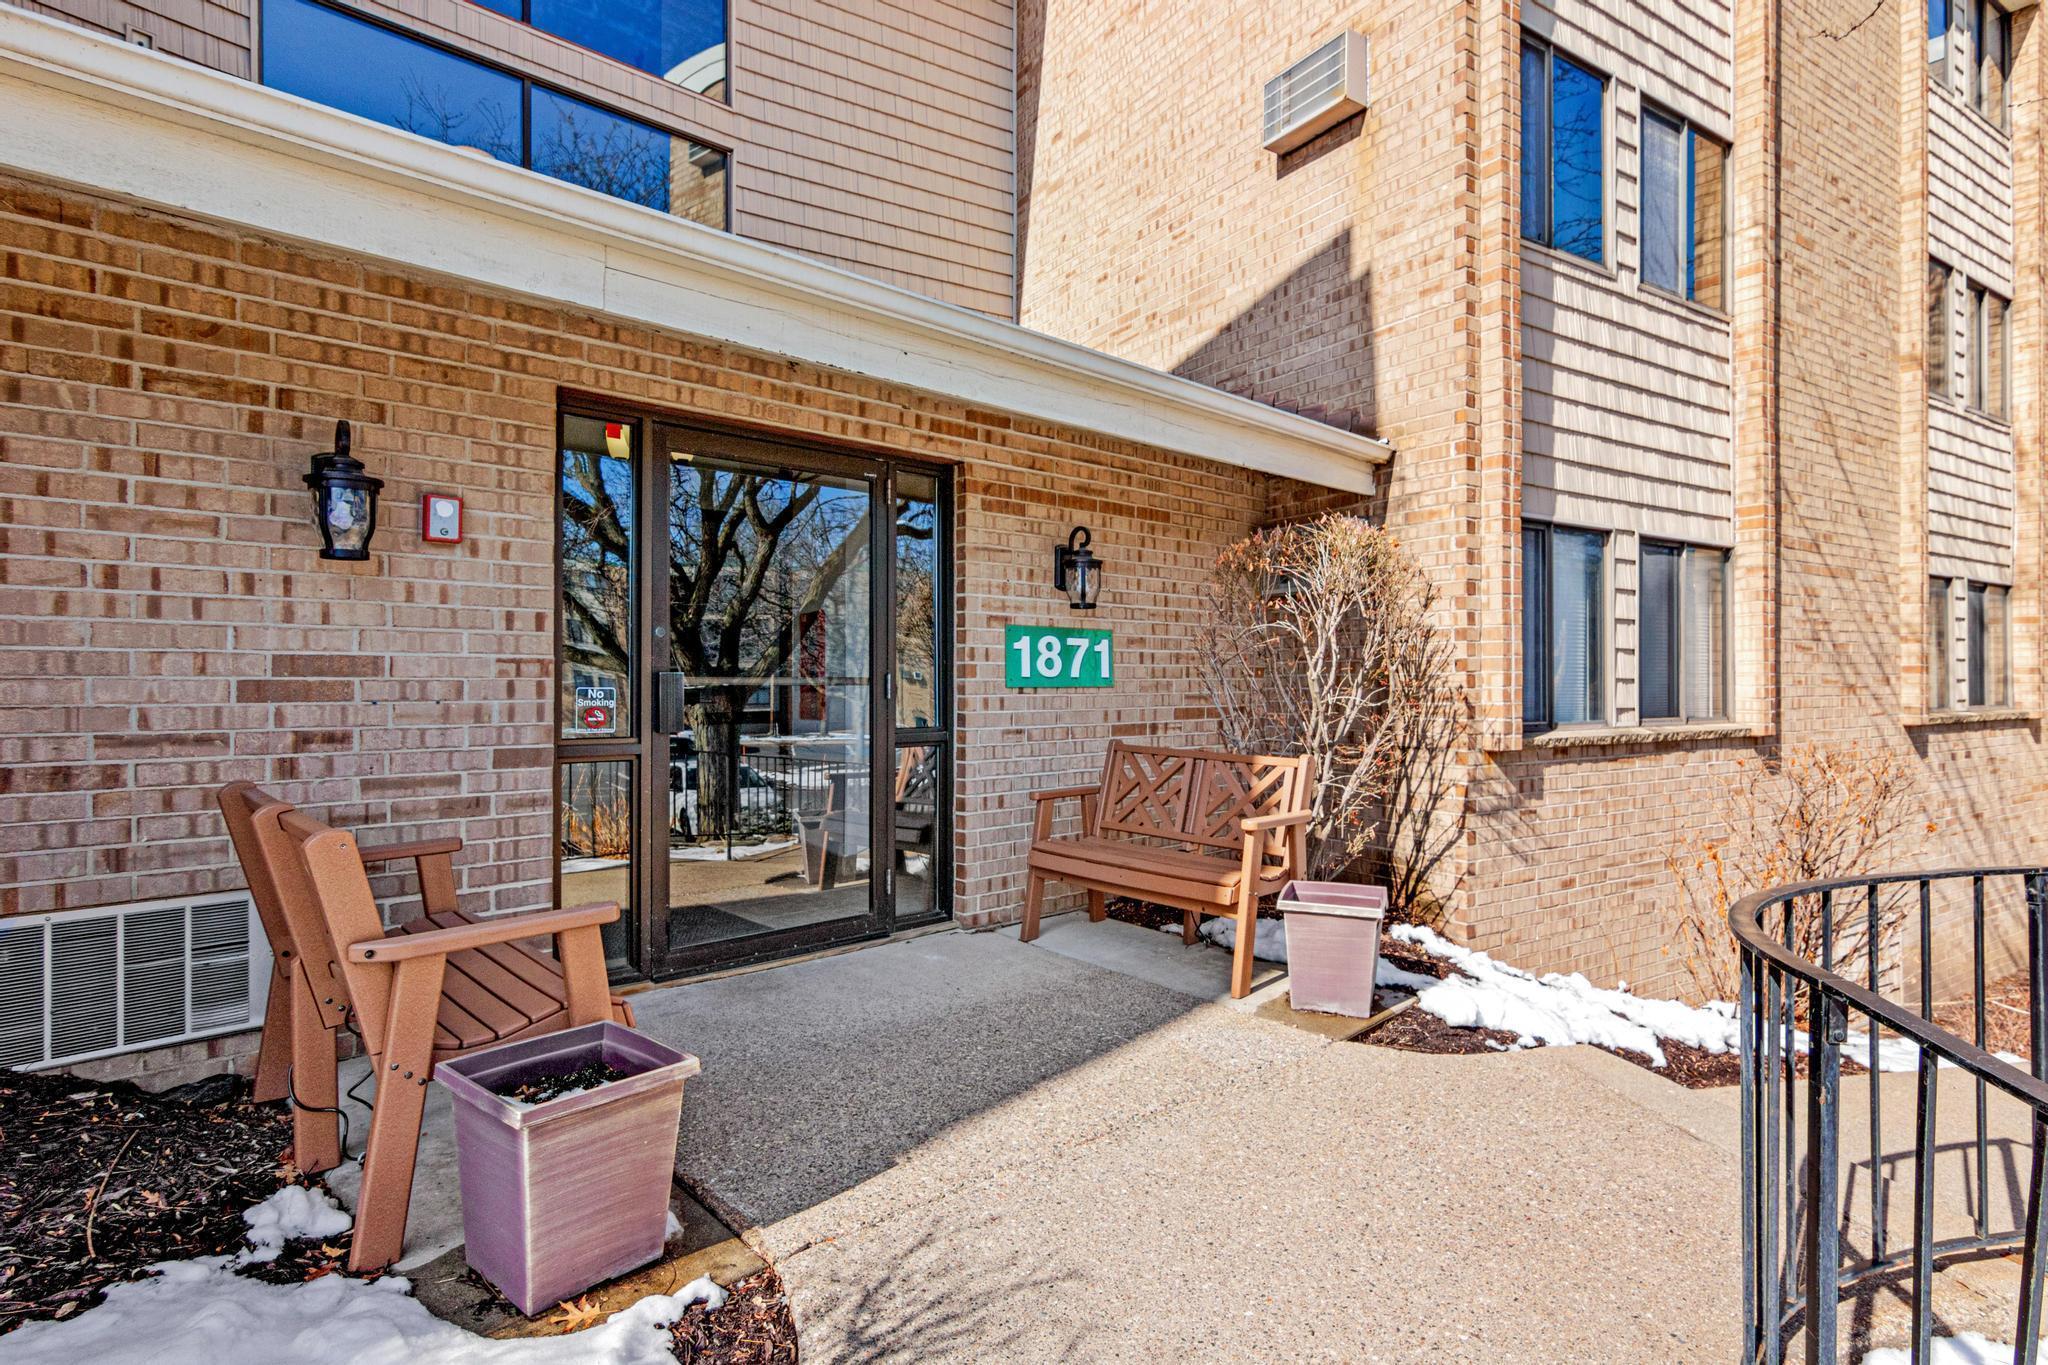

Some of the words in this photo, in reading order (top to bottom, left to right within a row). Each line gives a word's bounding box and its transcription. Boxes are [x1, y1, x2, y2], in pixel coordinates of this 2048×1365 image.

[1013, 635, 1110, 678] 1871
[588, 689, 604, 698] No
[577, 699, 614, 708] Smoking
